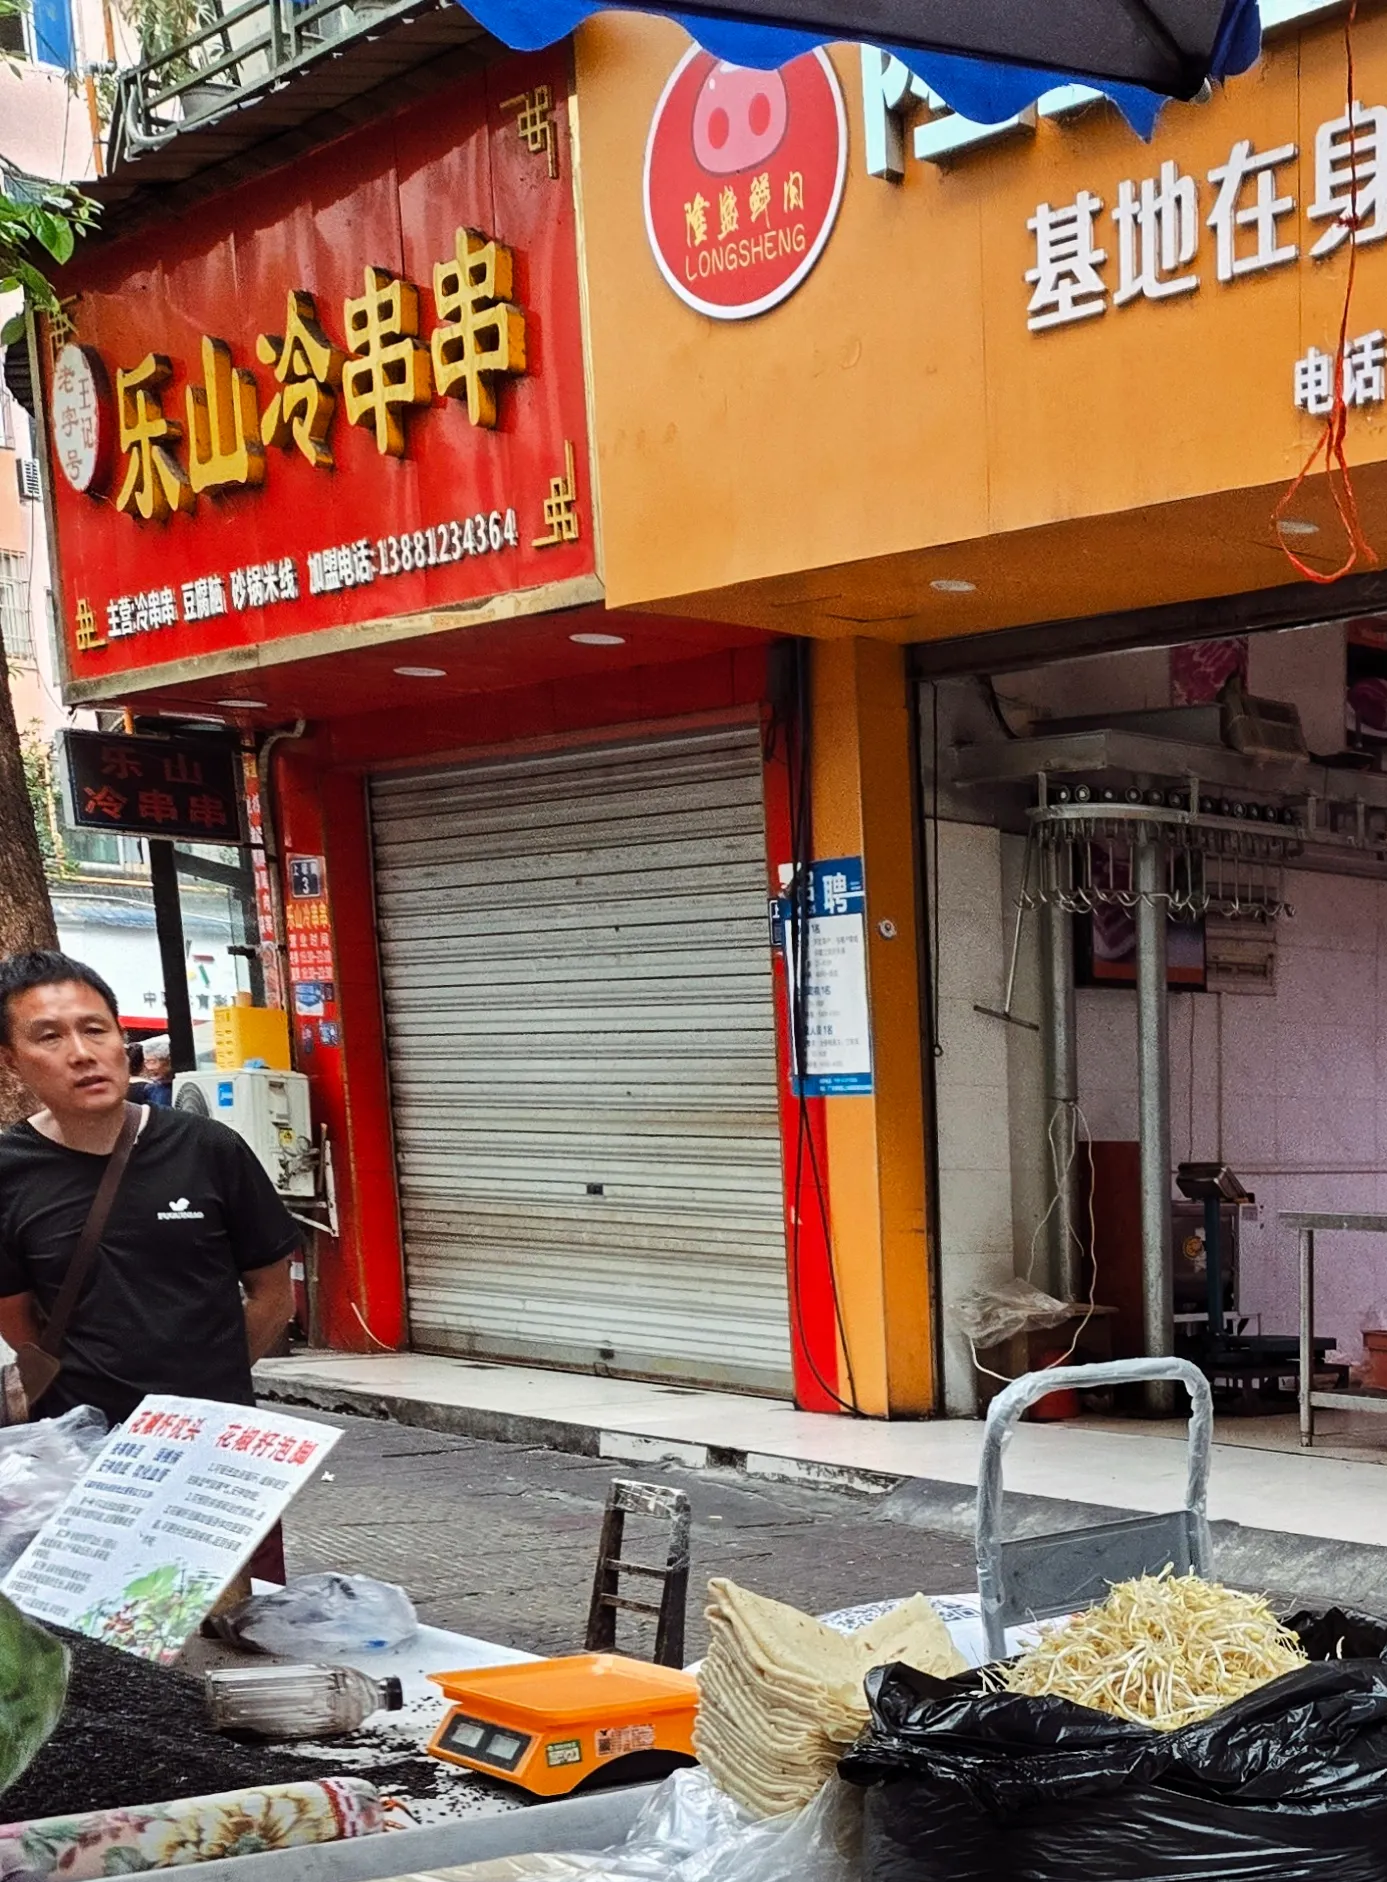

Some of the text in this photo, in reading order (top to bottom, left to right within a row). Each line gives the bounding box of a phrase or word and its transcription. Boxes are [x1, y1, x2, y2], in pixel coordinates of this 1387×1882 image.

[685, 224, 806, 281] LONGSHENG
[116, 226, 520, 522] 乐山冷串串
[101, 752, 202, 786] 乐山
[83, 784, 227, 829] 冷串串
